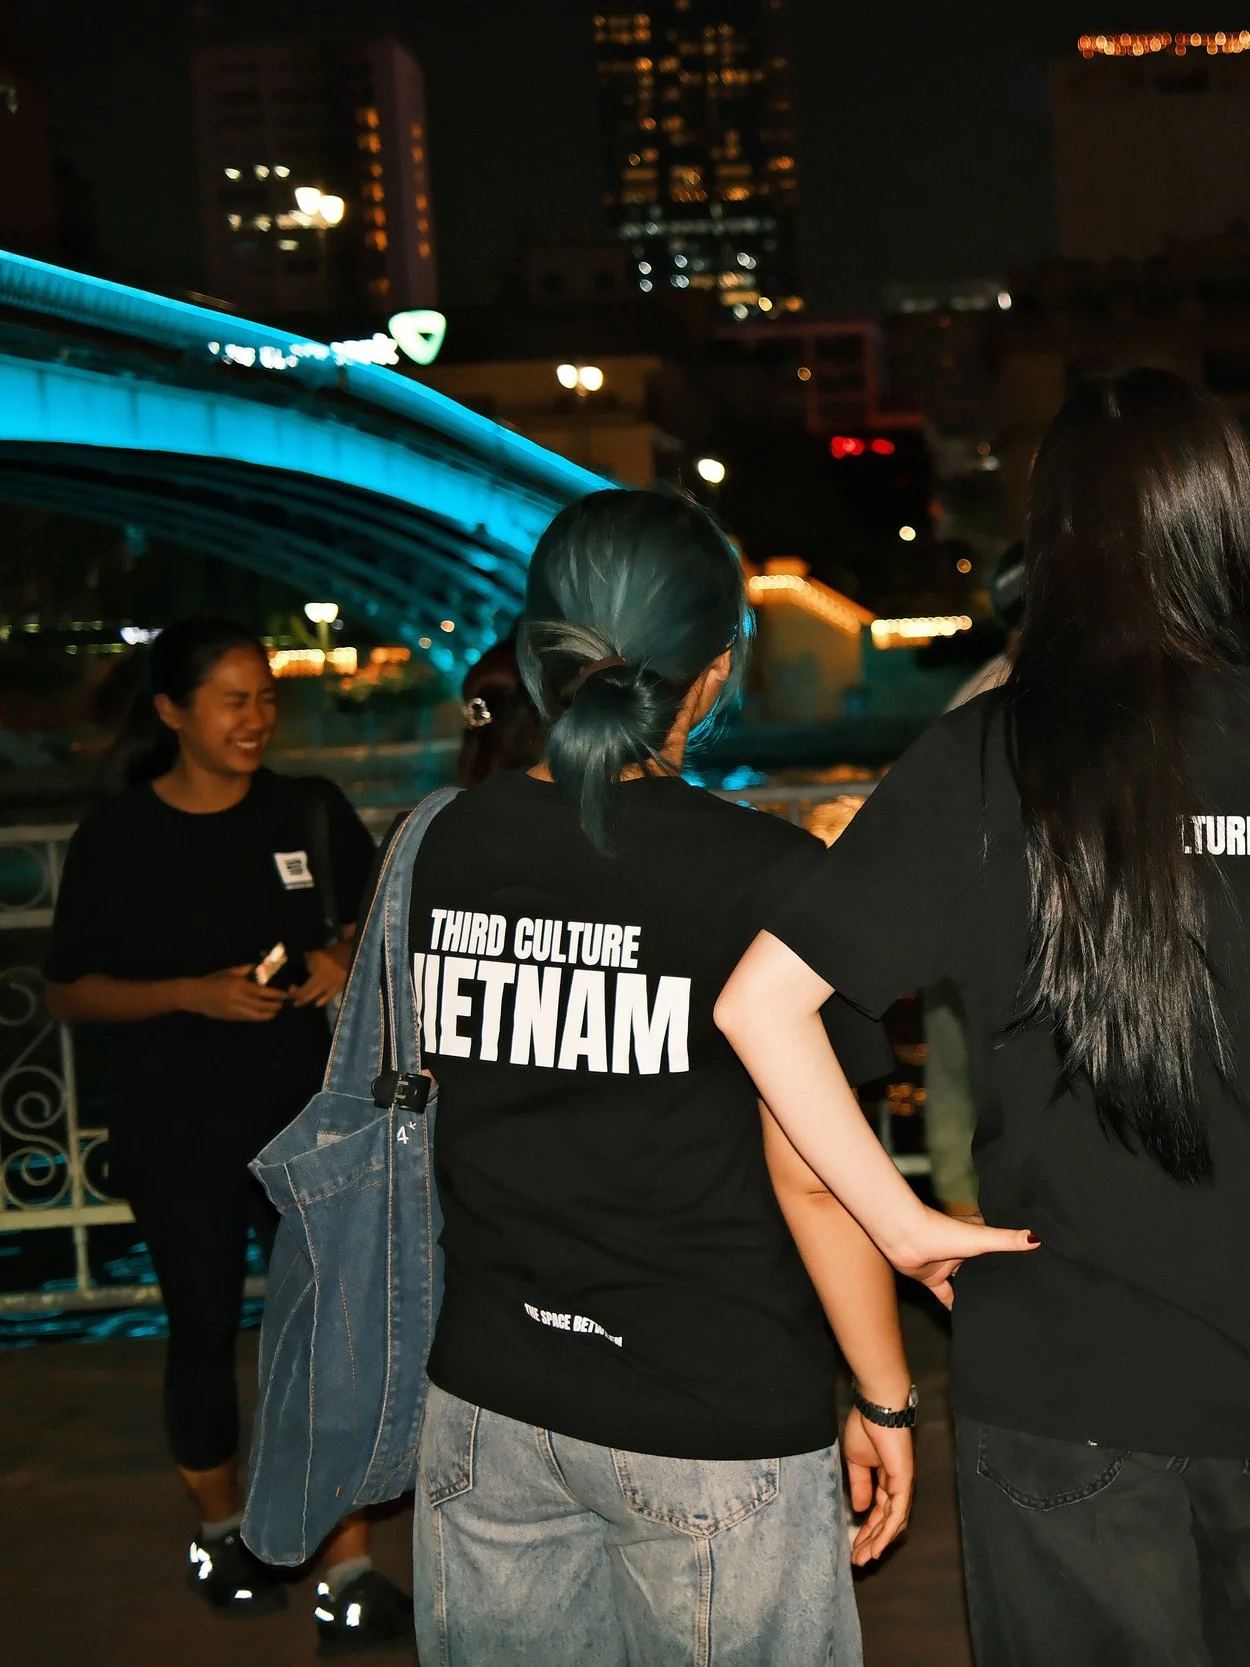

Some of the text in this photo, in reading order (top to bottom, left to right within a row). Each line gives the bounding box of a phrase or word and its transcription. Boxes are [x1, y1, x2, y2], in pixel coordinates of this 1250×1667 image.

[430, 908, 642, 969] THIRD CULTURE
[524, 1302, 541, 1322] THE
[540, 1309, 572, 1331] SPACE
